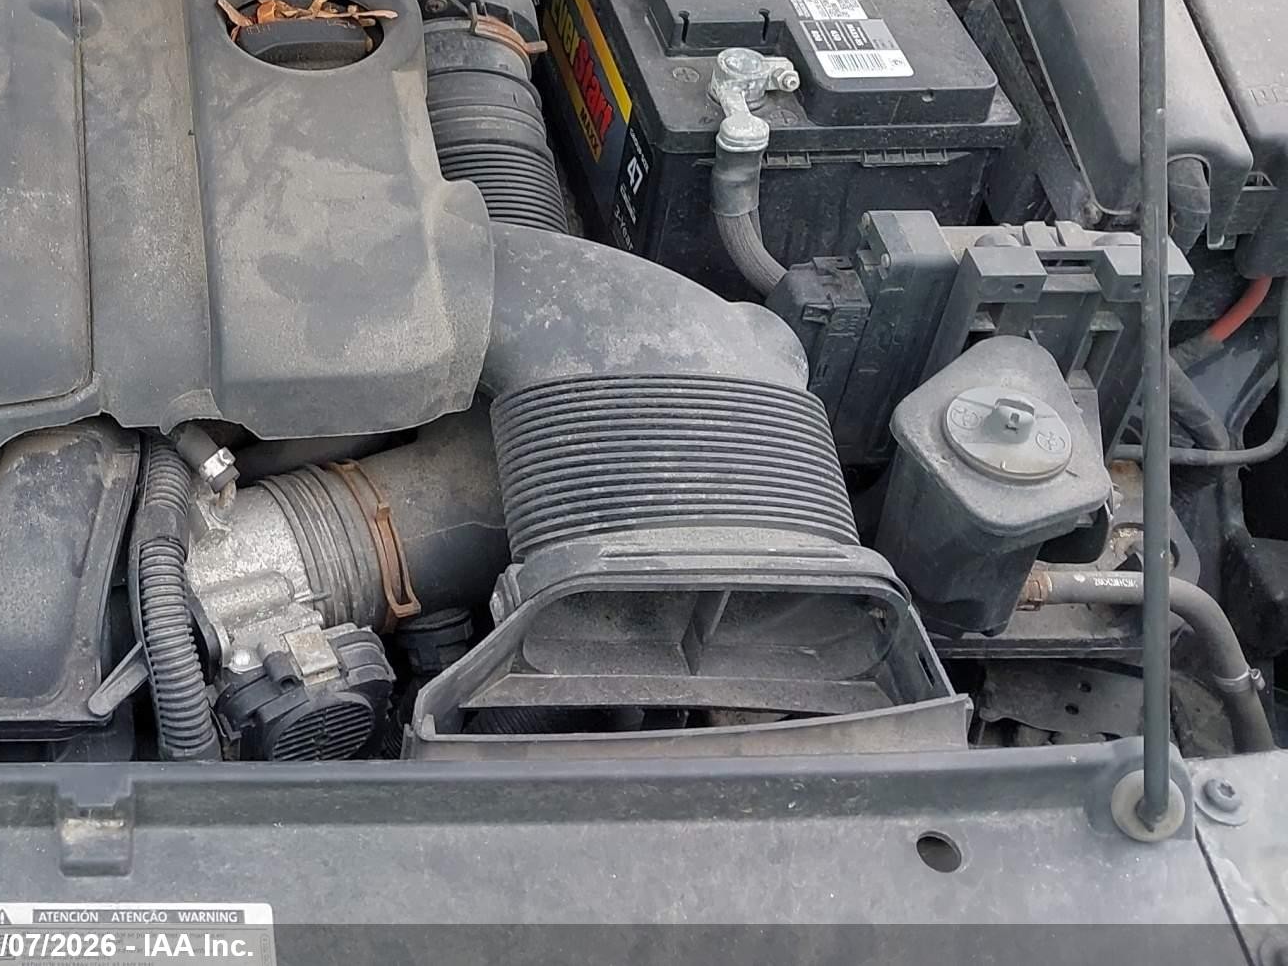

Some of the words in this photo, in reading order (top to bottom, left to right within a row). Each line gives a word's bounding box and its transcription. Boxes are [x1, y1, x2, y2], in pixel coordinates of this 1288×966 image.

[627, 156, 643, 194] 47
[38, 909, 99, 923] ATENCIÓN
[178, 911, 238, 923] WARNING
